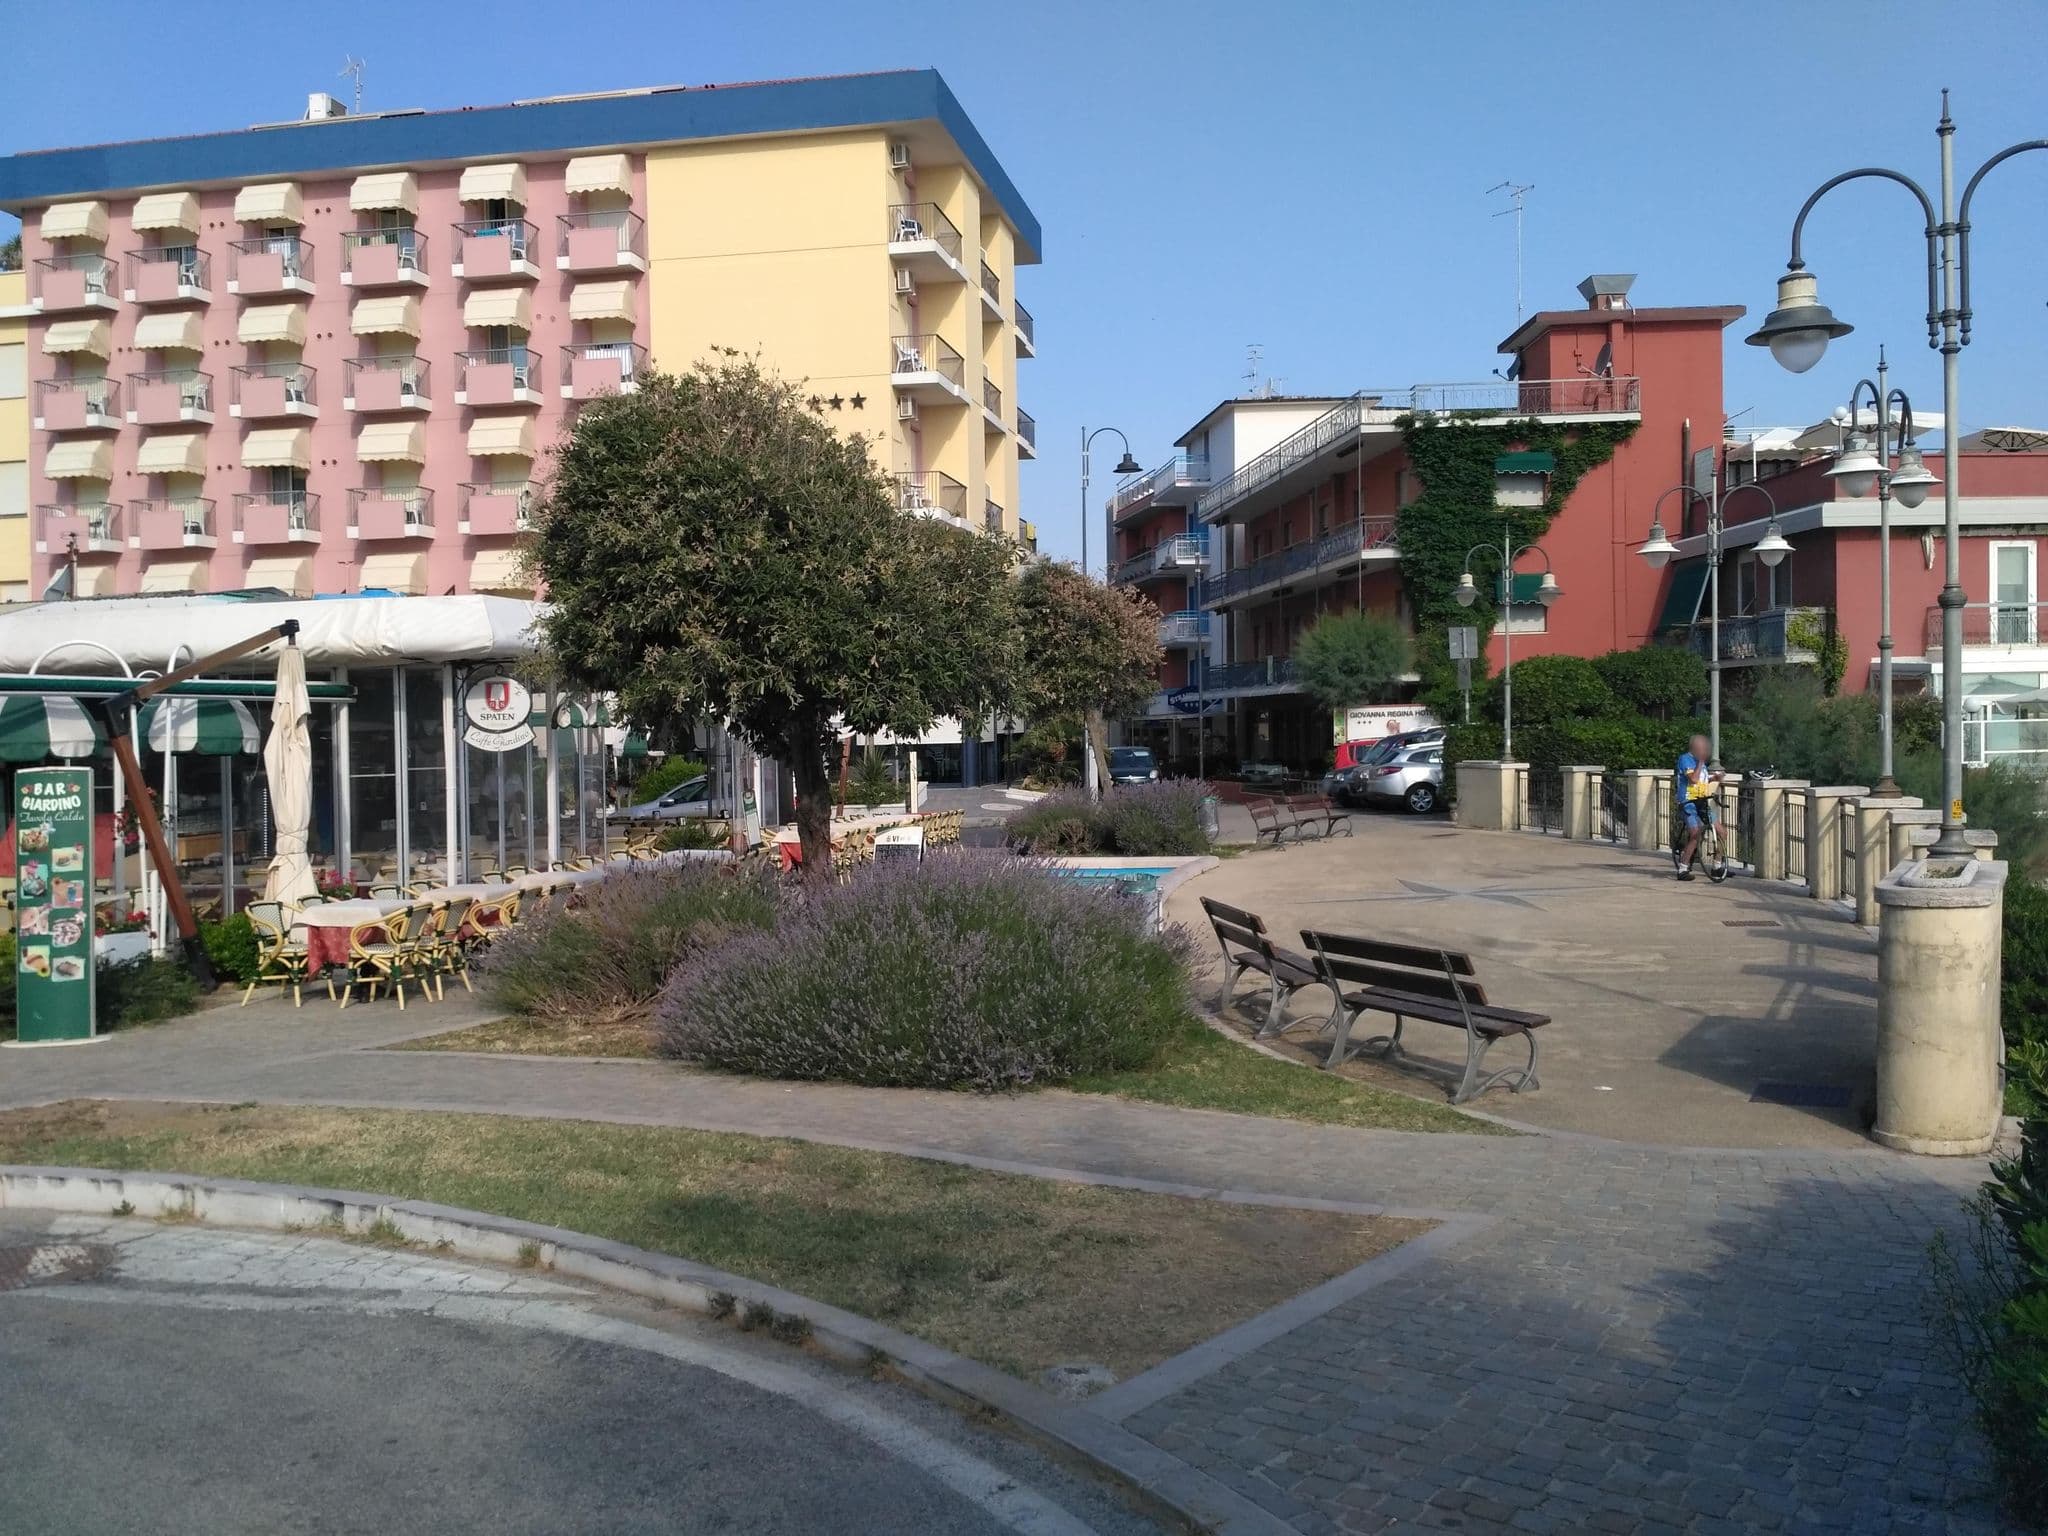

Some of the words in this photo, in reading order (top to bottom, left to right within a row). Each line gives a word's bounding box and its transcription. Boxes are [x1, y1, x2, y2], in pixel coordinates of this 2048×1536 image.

[480, 713, 515, 721] SPATEN
[1349, 711, 1385, 719] GIOVANNA
[1387, 709, 1413, 717] REGINA
[493, 731, 530, 746] Giardino
[33, 782, 67, 796] BAR
[22, 795, 81, 811] GIARDINO
[20, 810, 52, 822] Tavola
[55, 810, 85, 821] Calda
